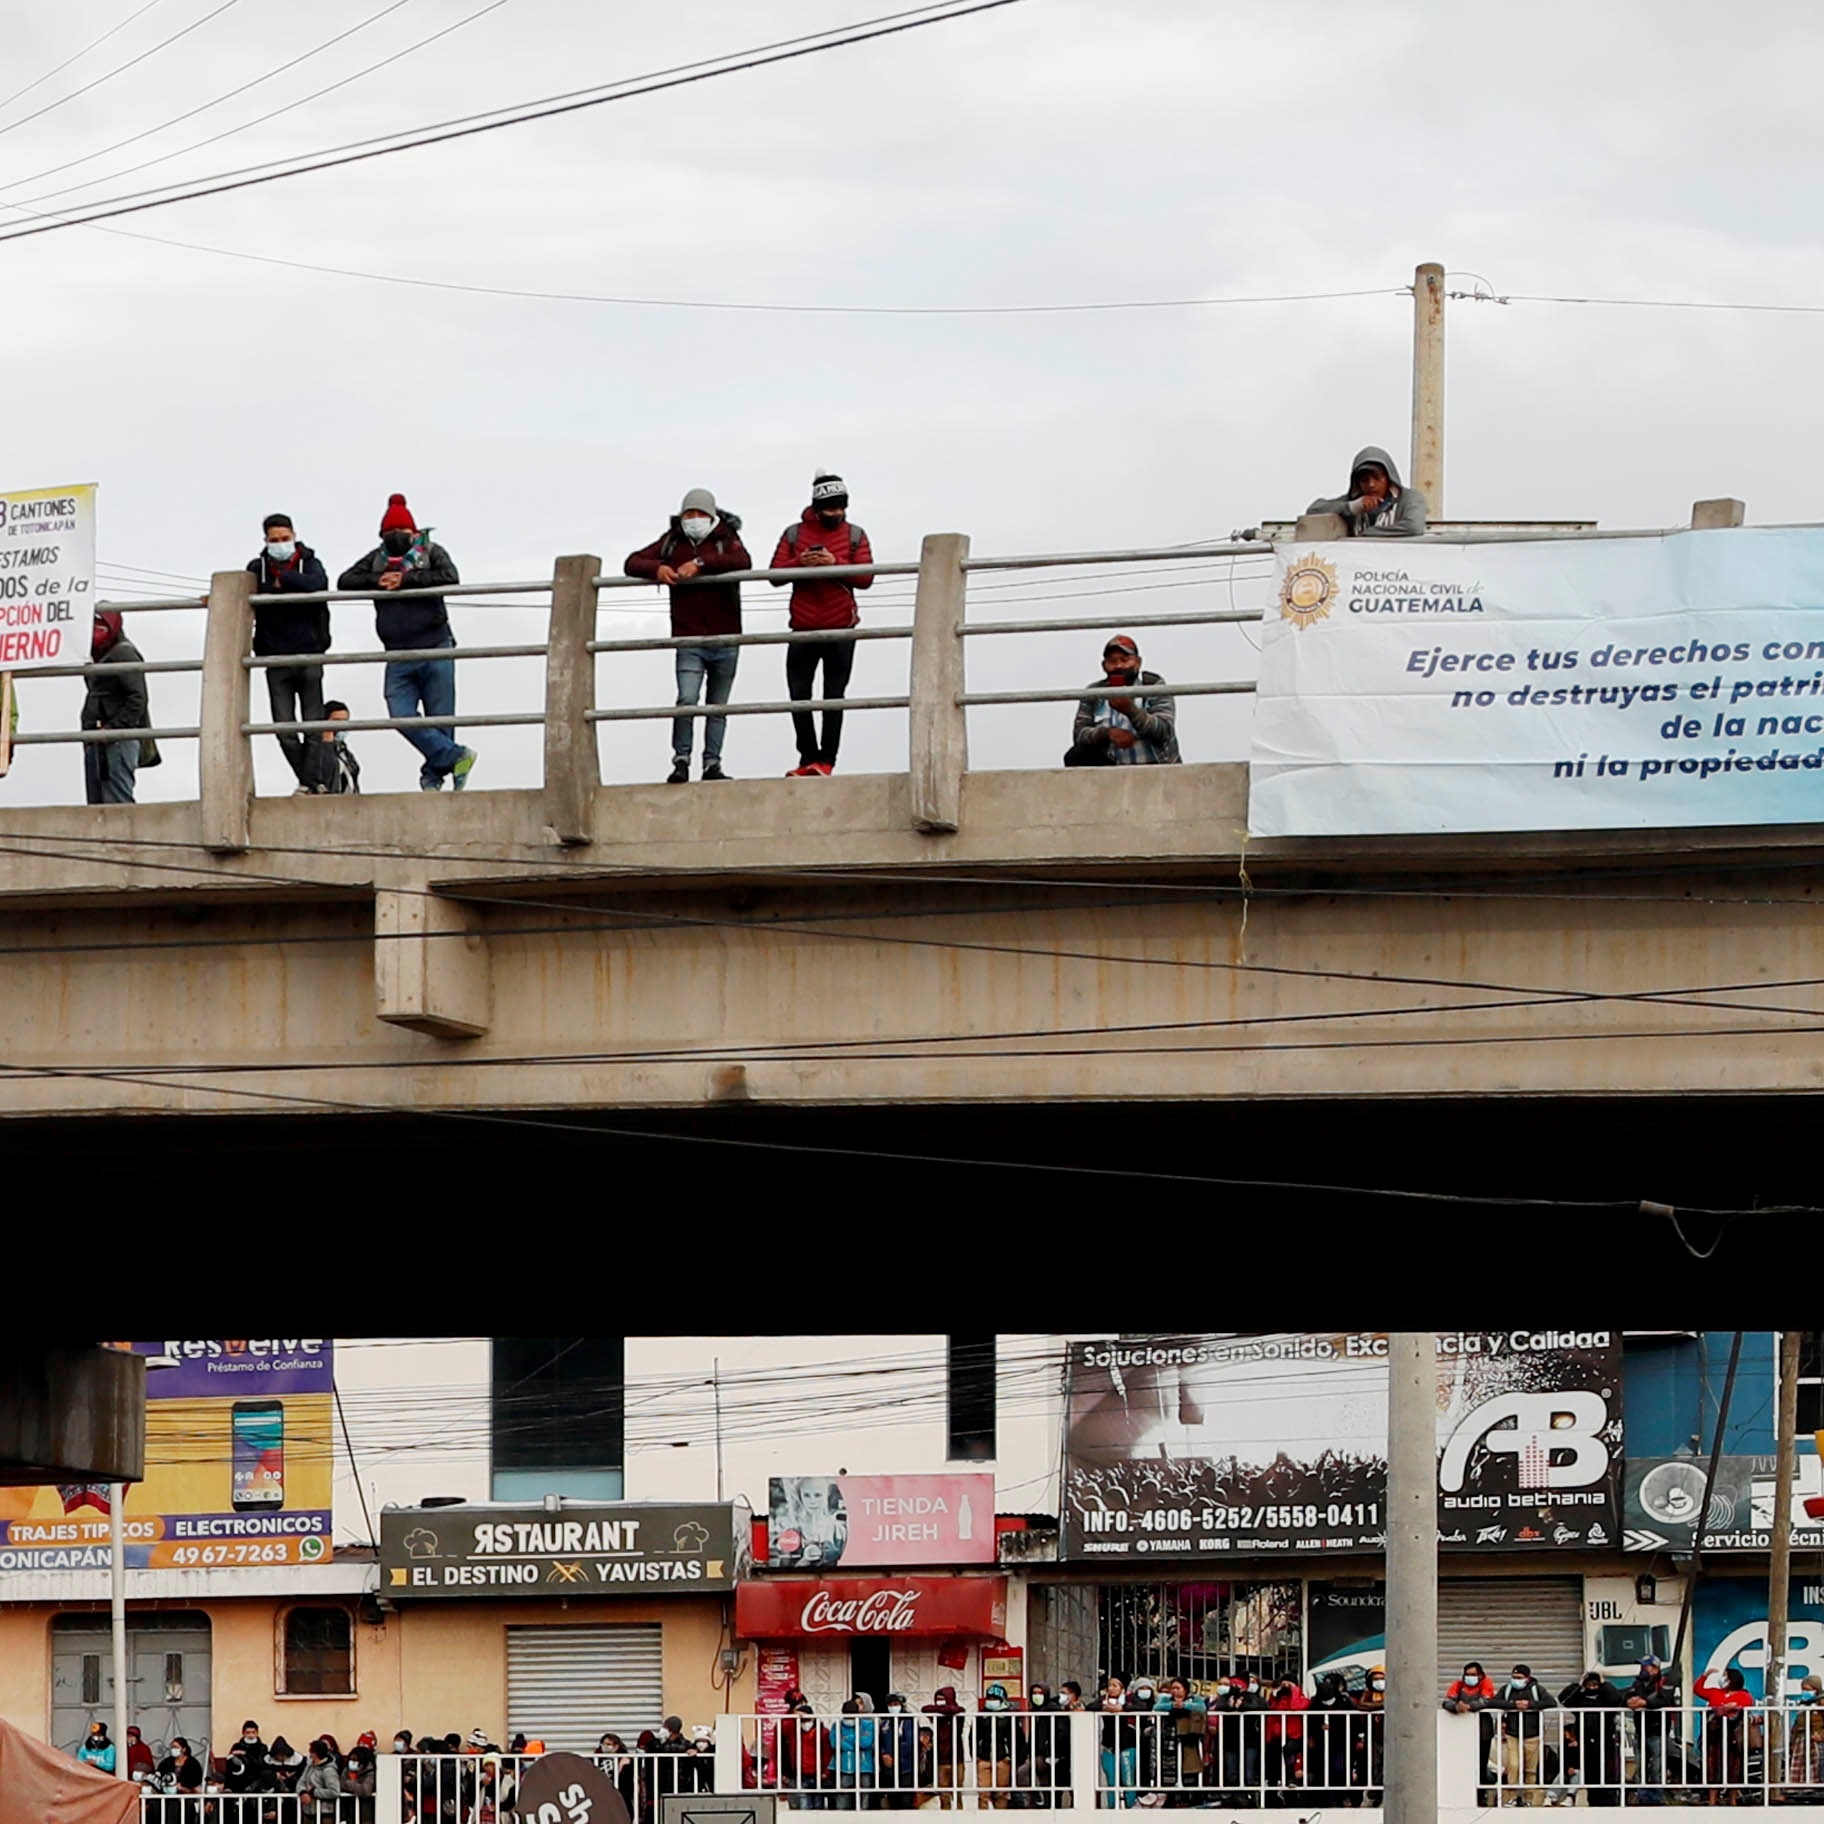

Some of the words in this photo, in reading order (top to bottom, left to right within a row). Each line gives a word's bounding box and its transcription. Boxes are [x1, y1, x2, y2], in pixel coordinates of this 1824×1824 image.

[10, 499, 76, 520] CANTONES
[8, 526, 18, 536] DE
[20, 519, 75, 534] TOTONICAPÁN
[1353, 569, 1409, 582] POLICÍA
[35, 579, 61, 596] de
[67, 577, 89, 593] la
[1351, 584, 1426, 595] NACIONAL
[1430, 583, 1464, 595] CIVIL
[46, 601, 74, 622] DEL
[1348, 598, 1484, 613] GUATEMALA
[1405, 646, 1515, 678] Ejerce
[1526, 648, 1578, 670] tus
[1590, 639, 1750, 668] derechos
[1451, 690, 1495, 708] no
[1507, 684, 1678, 710] destruyas
[1689, 675, 1722, 699] el
[1660, 715, 1702, 739] de
[1713, 713, 1746, 737] la
[1552, 755, 1588, 779] ni
[1596, 755, 1629, 776] la
[1638, 748, 1824, 781] propiedad
[1083, 1345, 1208, 1367] Soluciones
[1252, 1337, 1341, 1360] Sonido,
[1488, 1334, 1502, 1354] y
[1509, 1330, 1610, 1351] Calidad
[207, 1360, 254, 1373] Préstamo
[256, 1359, 270, 1371] de
[272, 1358, 323, 1371] Confianza
[861, 1497, 949, 1517] TIENDA
[1443, 1494, 1501, 1509] audio
[1507, 1492, 1606, 1507] bethania
[175, 1516, 323, 1537] ELECTRONICOS
[1140, 1503, 1379, 1532] 4606-5252/5558-0411
[10, 1524, 78, 1541] TRAJES
[80, 1521, 155, 1538] TIPCOS
[872, 1521, 939, 1543] JIREH
[1789, 1528, 1824, 1547] écni
[172, 1543, 287, 1565] 4967-7263
[1149, 1540, 1191, 1551] YAMAHA
[1199, 1538, 1230, 1550] KORG
[1252, 1539, 1289, 1550] Roland
[412, 1567, 439, 1586] EL
[444, 1564, 539, 1585] DESTINO
[596, 1560, 702, 1582] YAVISTAS
